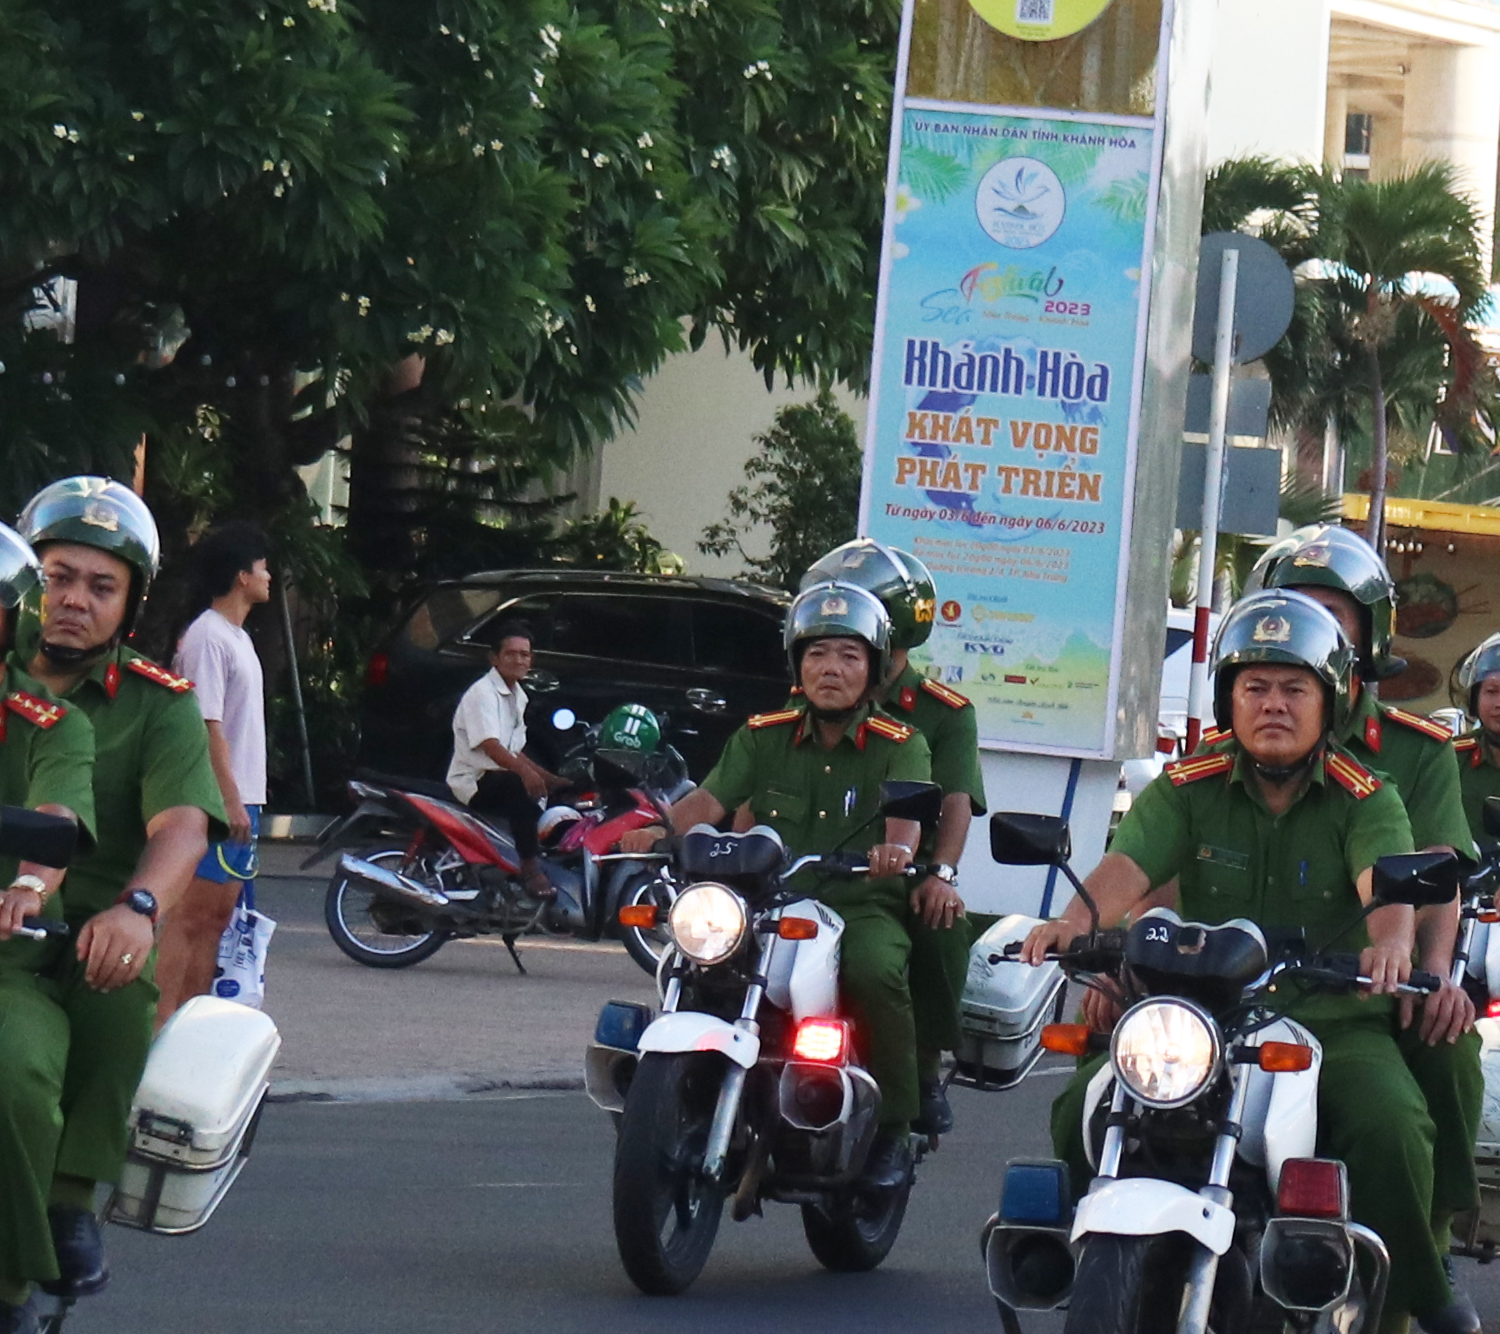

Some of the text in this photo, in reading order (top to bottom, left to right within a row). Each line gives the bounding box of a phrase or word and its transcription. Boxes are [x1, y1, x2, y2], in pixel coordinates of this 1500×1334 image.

[934, 123, 959, 134] BAN
[963, 123, 998, 137] NHÂN
[1002, 126, 1028, 139] DÂN
[1063, 131, 1105, 146] KHÁNH
[1109, 135, 1136, 149] HÒA
[1044, 300, 1091, 317] 2023
[904, 338, 1110, 403] Khánh Hòa
[905, 407, 1100, 459] KHÁT VỌNG
[895, 454, 1102, 502] PHÁT TRIỂN
[885, 503, 1105, 535] Từ ngày 03/6 đến ngày 06/6/2023
[613, 731, 642, 748] Grab
[709, 841, 739, 858] 25
